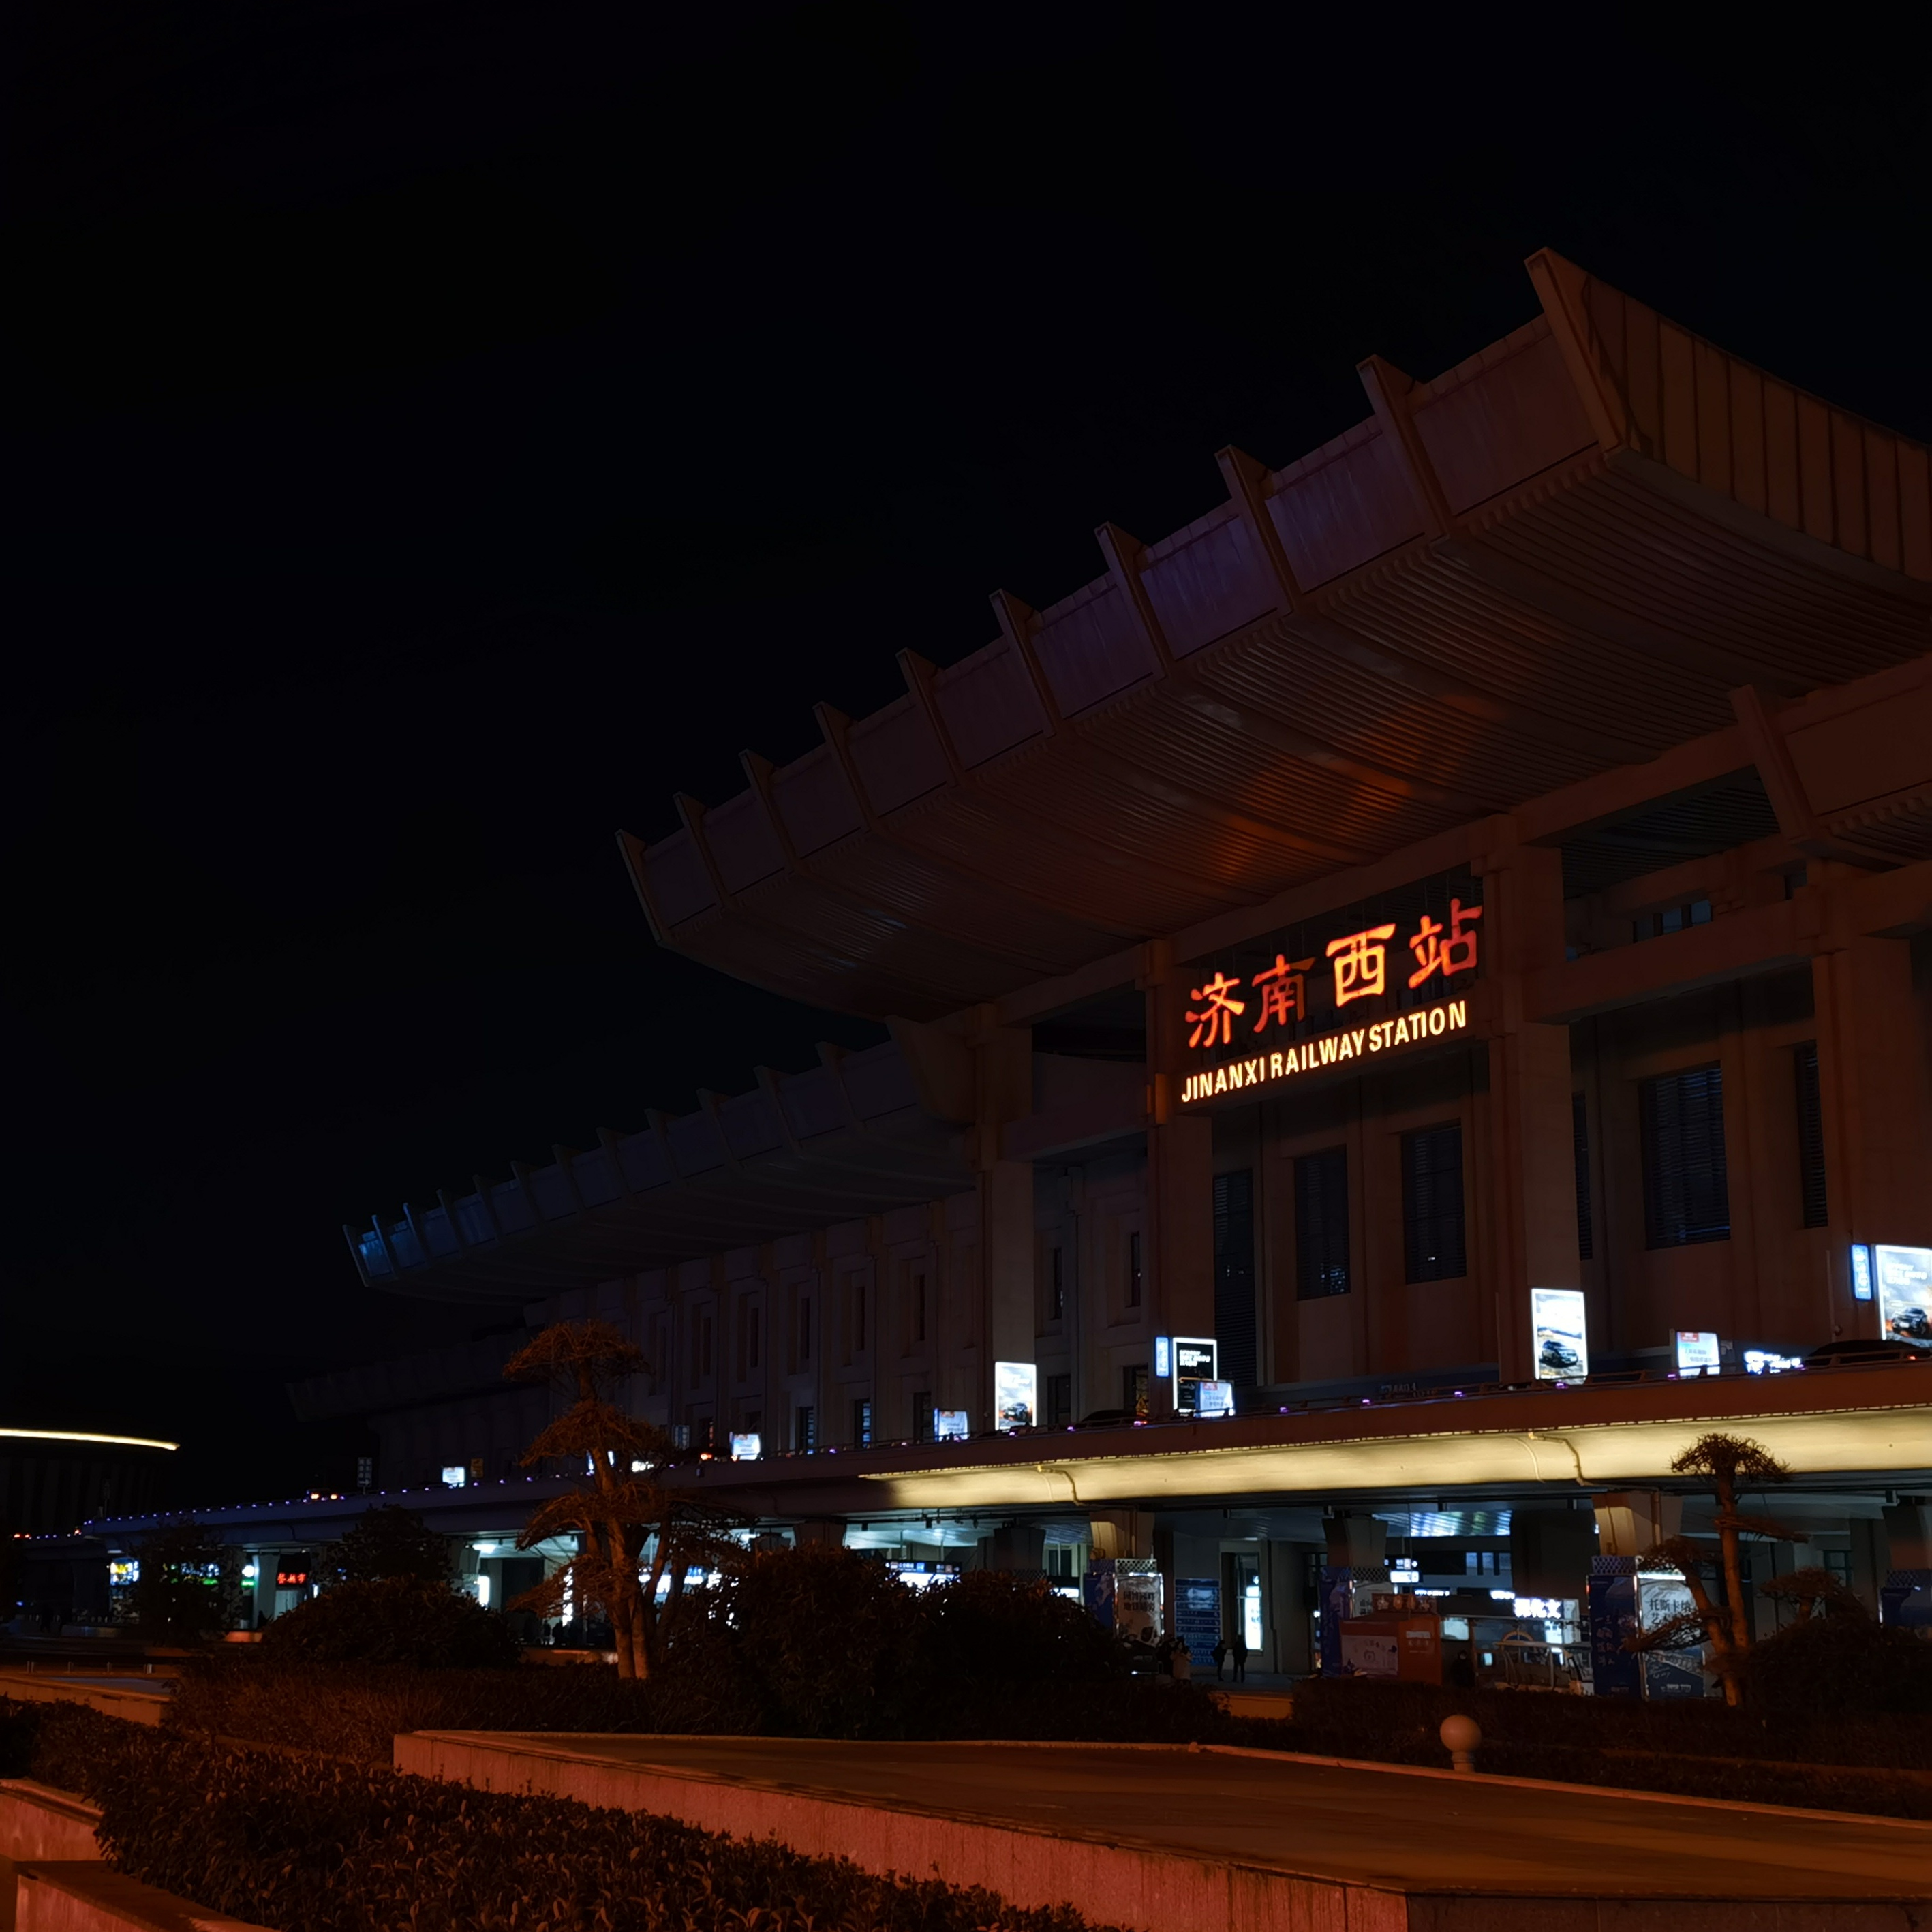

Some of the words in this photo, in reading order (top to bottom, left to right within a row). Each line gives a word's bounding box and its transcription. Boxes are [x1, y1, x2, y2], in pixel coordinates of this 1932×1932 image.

[1185, 898, 1482, 1048] 济南西站
[1181, 1056, 1266, 1103] JINANXI
[1270, 1028, 1366, 1079] RAILWAY
[1368, 1000, 1467, 1052] STATION
